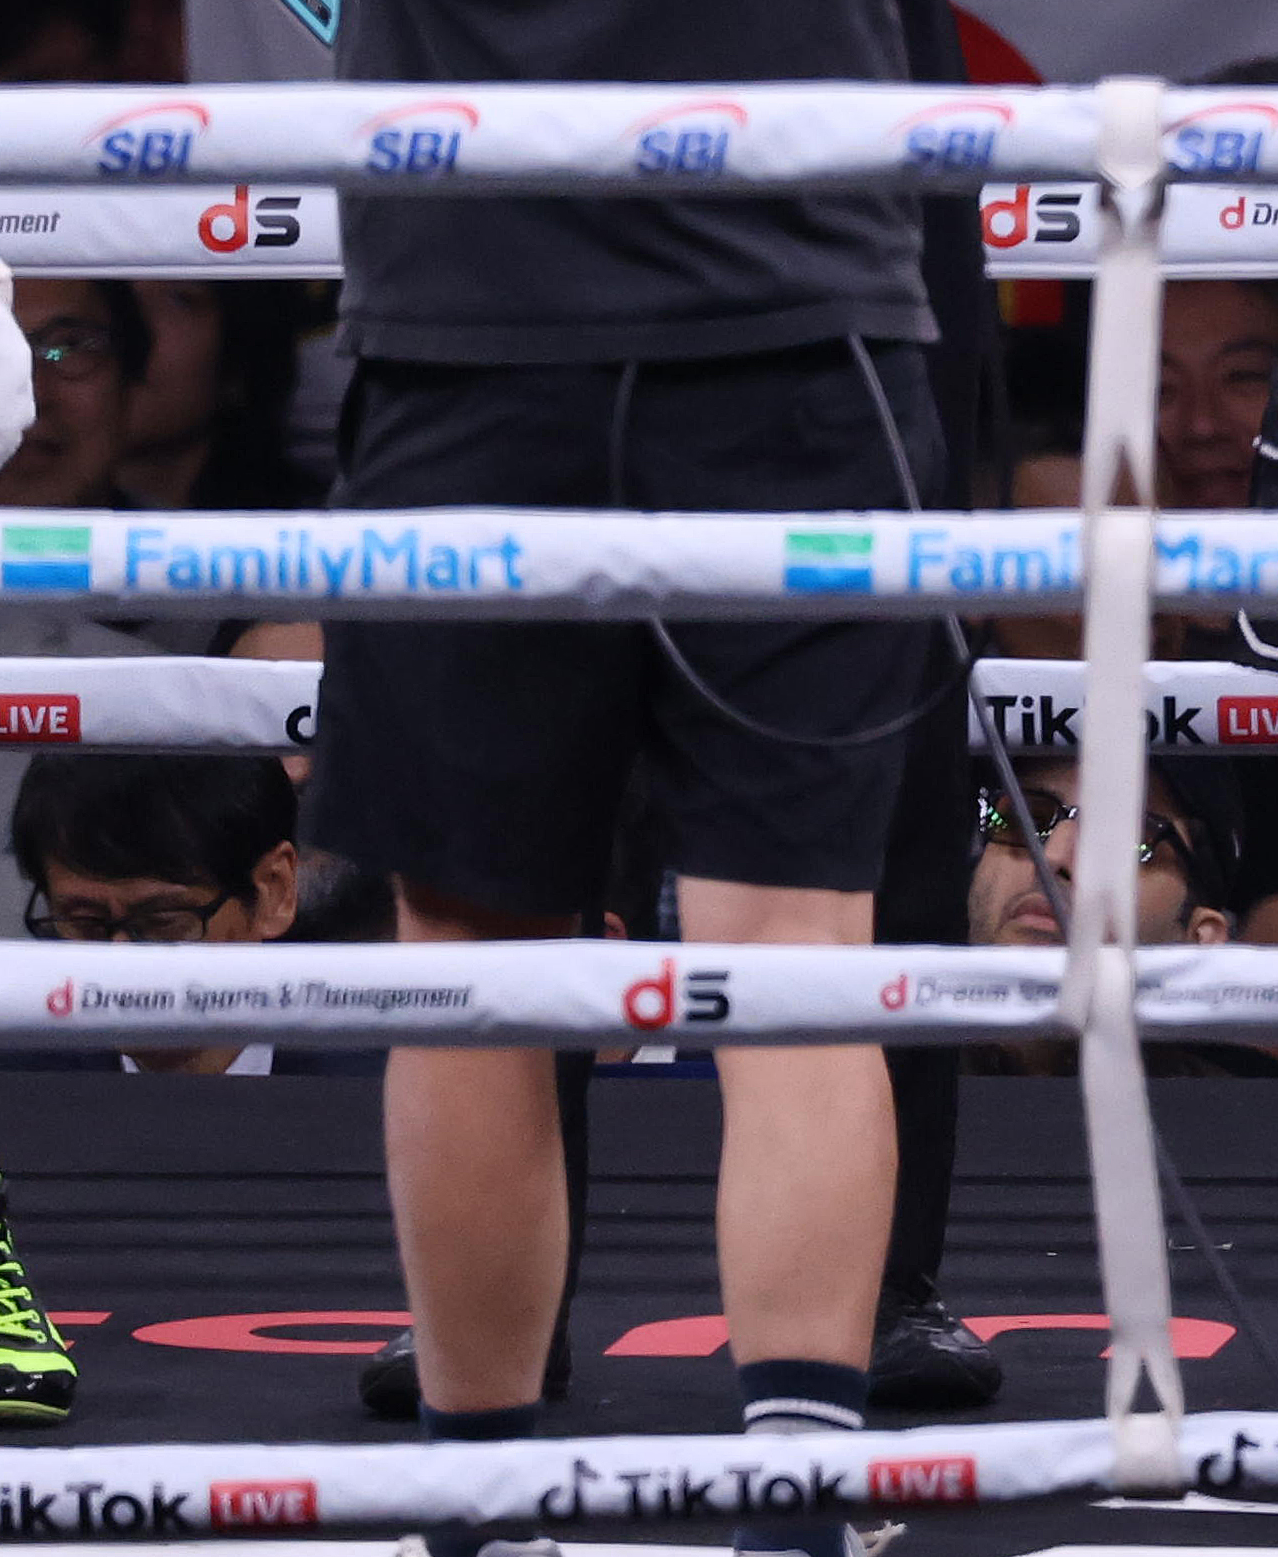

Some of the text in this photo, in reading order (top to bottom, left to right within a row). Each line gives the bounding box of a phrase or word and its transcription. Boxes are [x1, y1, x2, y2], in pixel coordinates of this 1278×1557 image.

[97, 127, 194, 175] SBI
[366, 127, 463, 174] SBI
[636, 125, 731, 173] SBI
[904, 125, 999, 167] SBI
[1170, 127, 1266, 174] SBI
[124, 527, 525, 598] FamilyMart
[615, 1459, 852, 1520] TikTok
